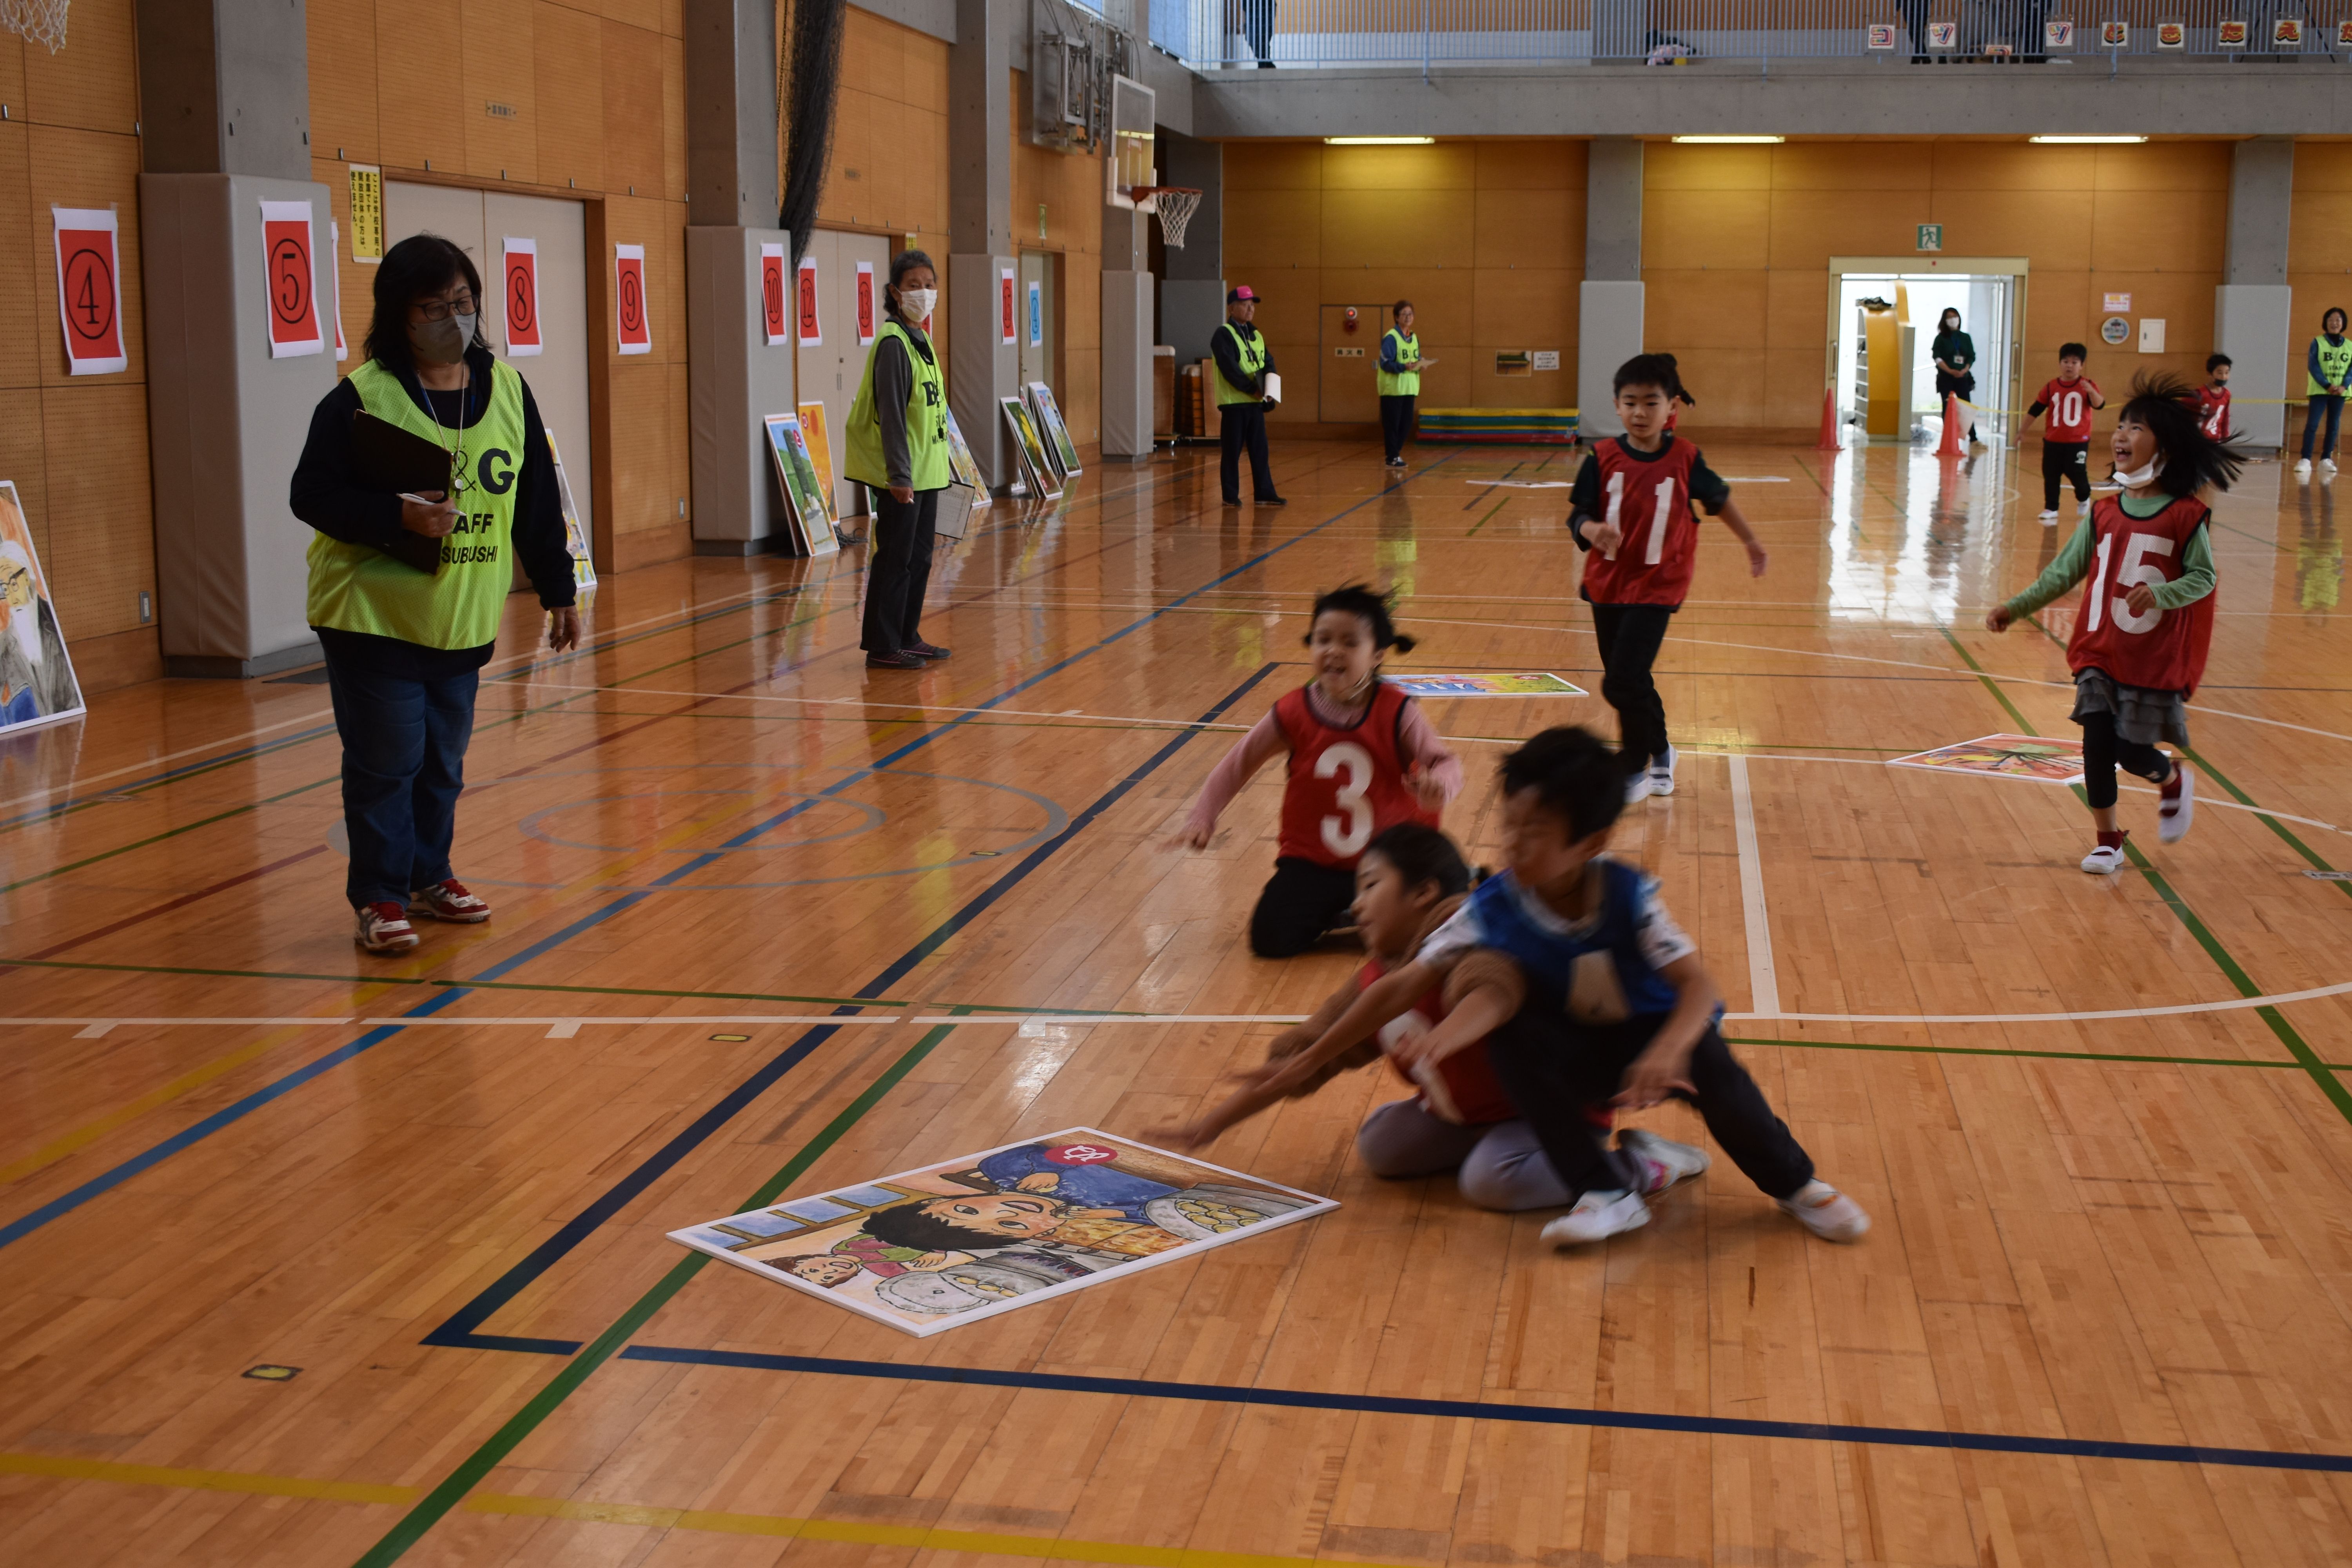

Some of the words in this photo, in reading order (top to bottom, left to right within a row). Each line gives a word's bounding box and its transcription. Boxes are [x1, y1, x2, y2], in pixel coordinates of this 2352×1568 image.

[2052, 391, 2083, 427] 10
[452, 513, 494, 534] AFF
[1604, 472, 1675, 565] 11
[441, 545, 498, 564] SUBUSHI
[2087, 532, 2175, 634] 15
[1314, 740, 1374, 858] 3
